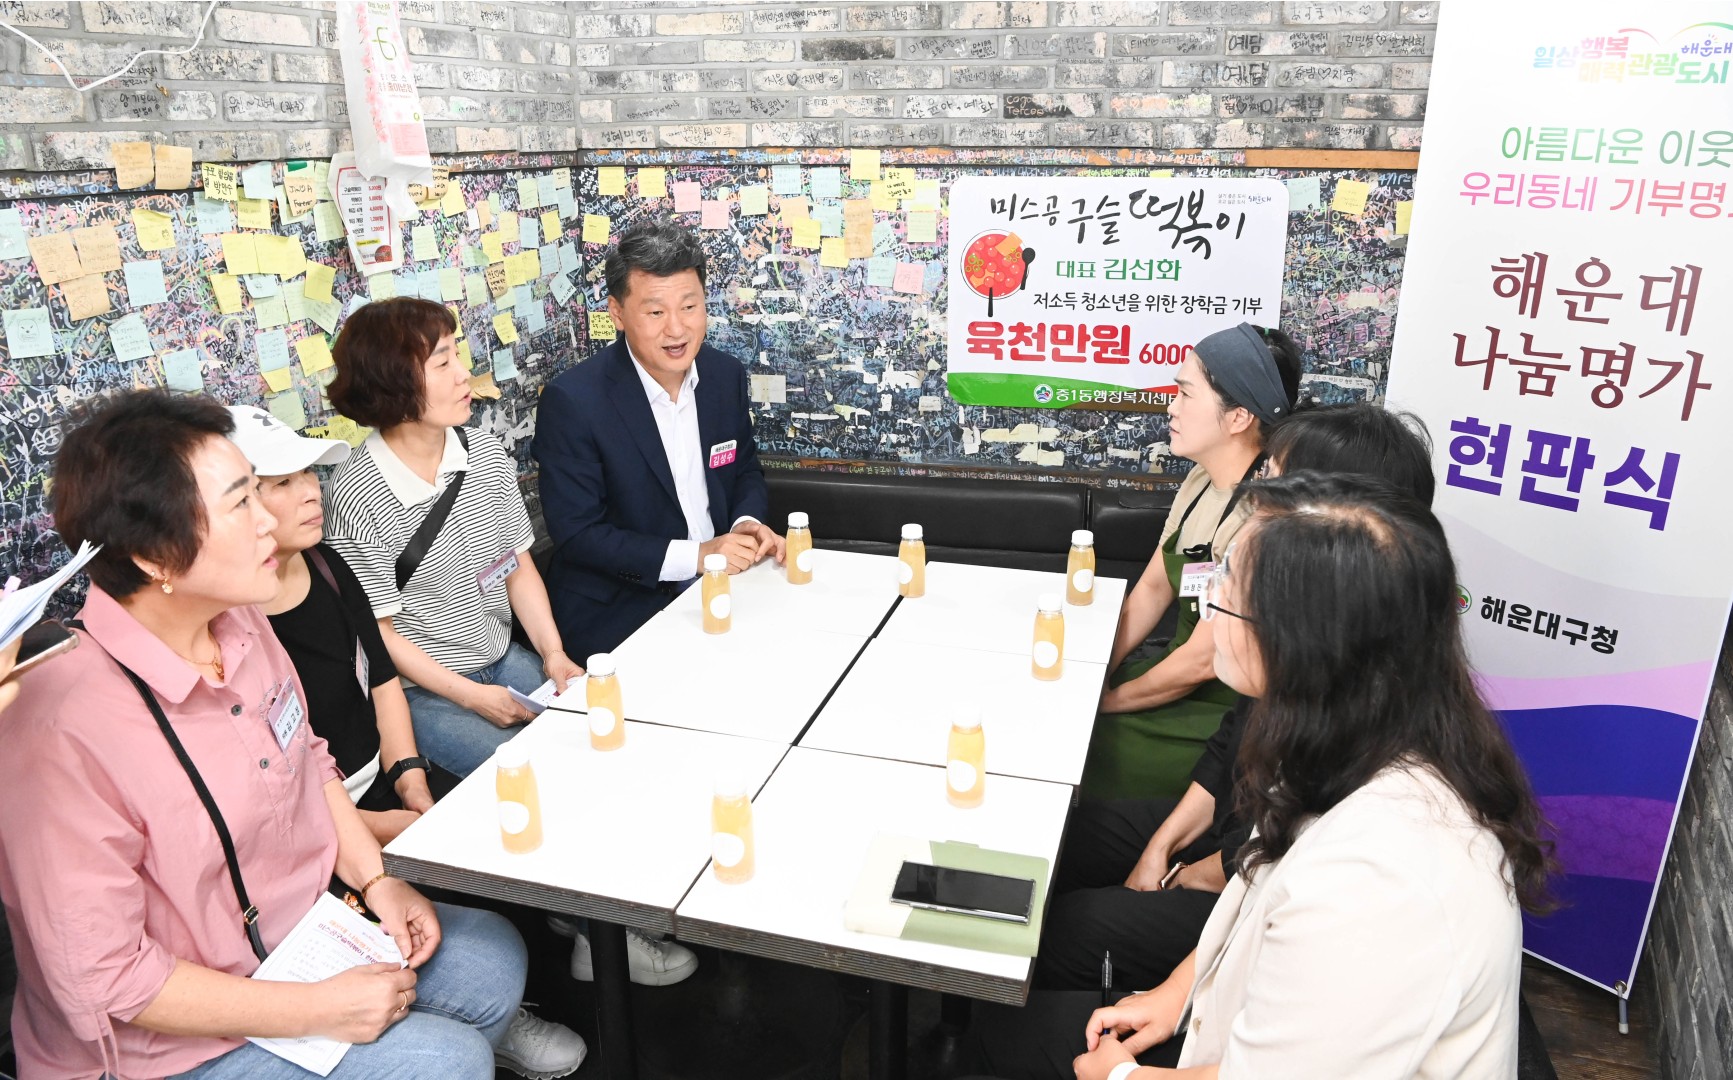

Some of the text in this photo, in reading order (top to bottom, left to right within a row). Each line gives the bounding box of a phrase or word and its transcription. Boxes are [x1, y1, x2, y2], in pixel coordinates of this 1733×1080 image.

[1533, 36, 1629, 69] 일상 행복
[1501, 126, 1733, 168] 아름다운 이웃
[989, 192, 1061, 227] 미스공
[1067, 194, 1122, 245] 구슬
[1459, 171, 1733, 219] 우리동네 기부명
[1056, 257, 1182, 282] 대표 김선화
[1033, 292, 1263, 316] 저소득 청소년을 위한 장학금 기부
[1491, 251, 1703, 337] 해운대
[966, 320, 1131, 366] 육천만원
[1452, 325, 1713, 422] 나눔명가
[713, 451, 734, 467] 김성수
[1445, 416, 1681, 532] 현판식
[1480, 595, 1620, 656] 해운대구청
